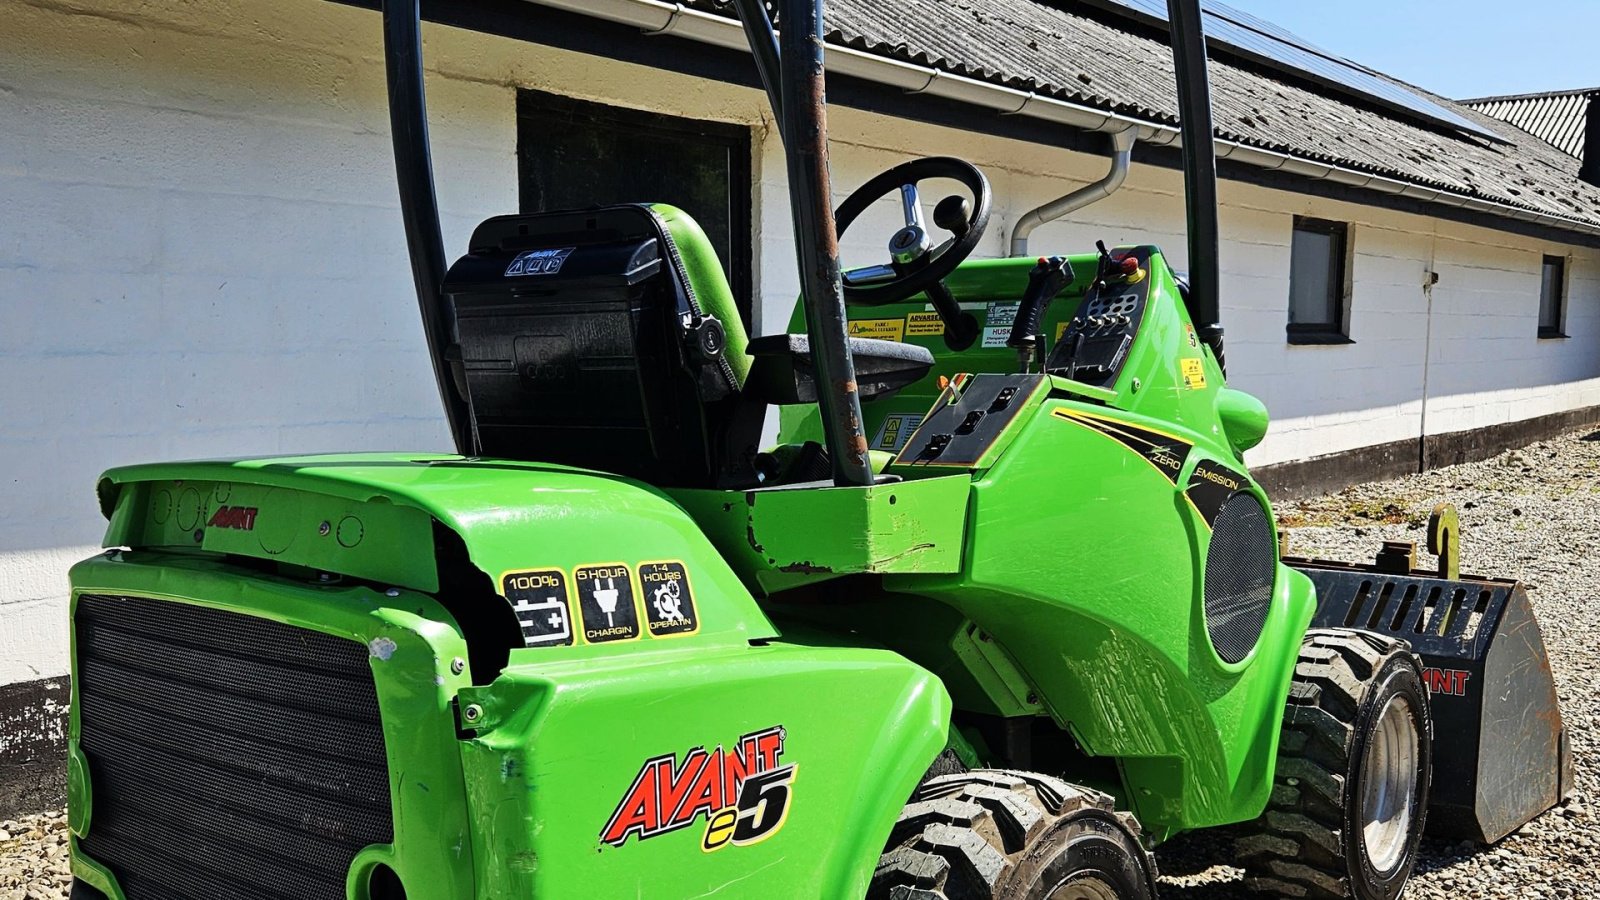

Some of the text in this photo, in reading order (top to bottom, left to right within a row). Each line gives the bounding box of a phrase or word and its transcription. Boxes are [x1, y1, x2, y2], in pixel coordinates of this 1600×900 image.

[1152, 453, 1181, 471] ZERO
[1195, 467, 1239, 490] EMISSION
[207, 505, 259, 531] AVANT
[577, 567, 627, 580] 5 HOUR
[652, 564, 669, 572] 1-4
[509, 575, 559, 590] 100%
[643, 571, 682, 582] HOURS
[649, 618, 692, 630] OPERATIN
[586, 626, 632, 639] CHARGIN
[600, 725, 784, 847] AVANT
